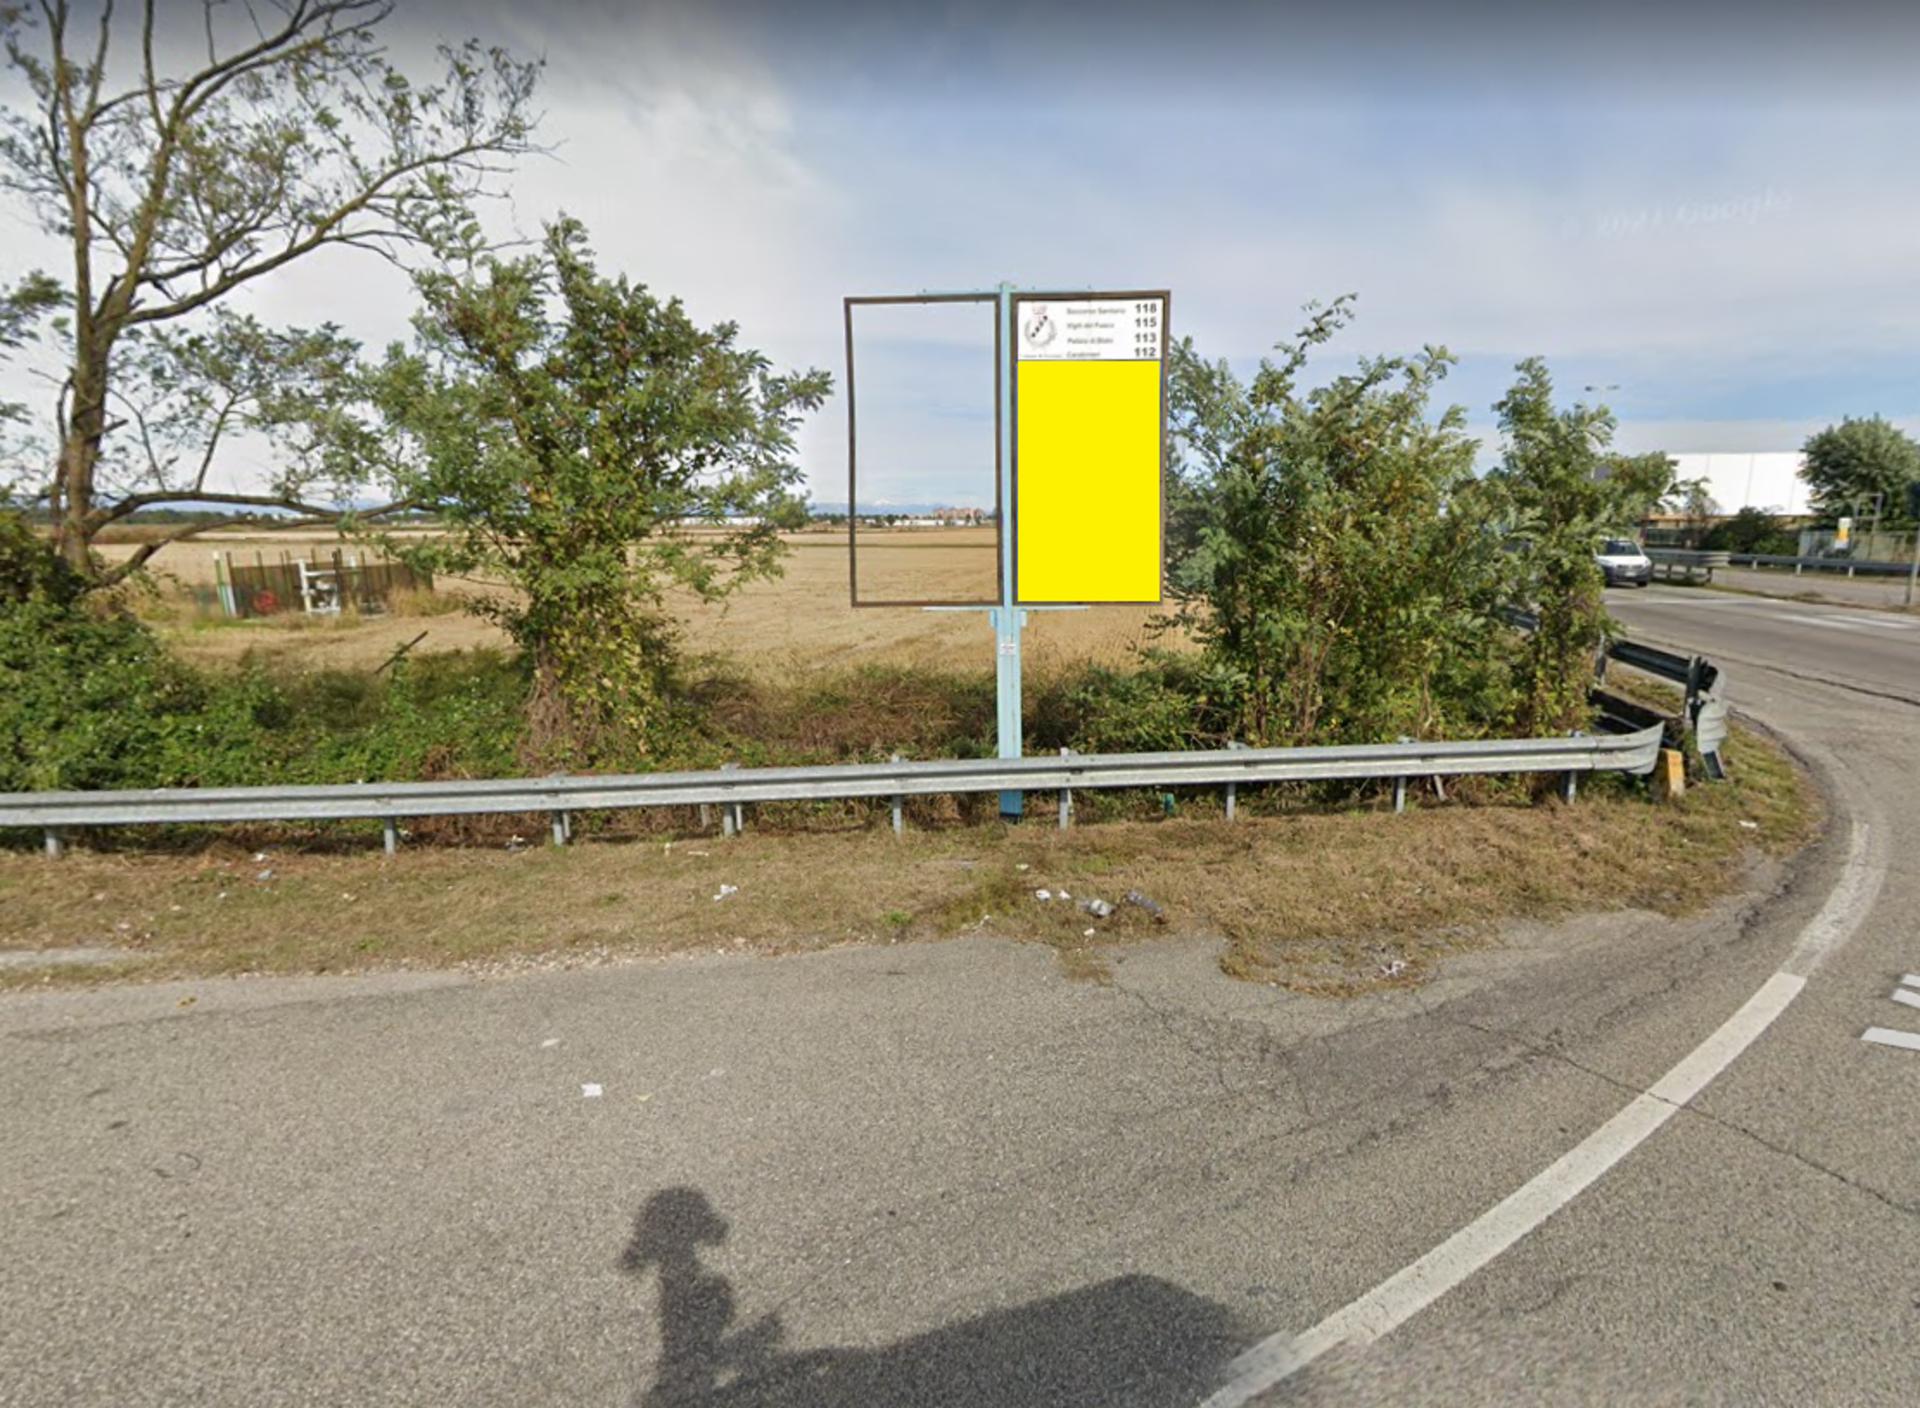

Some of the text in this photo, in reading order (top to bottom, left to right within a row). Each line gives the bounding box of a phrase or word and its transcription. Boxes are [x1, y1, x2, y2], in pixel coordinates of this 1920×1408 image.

[1135, 303, 1157, 314] 118
[1135, 317, 1157, 328] 115
[1134, 332, 1157, 343] 113
[1134, 347, 1157, 357] 112
